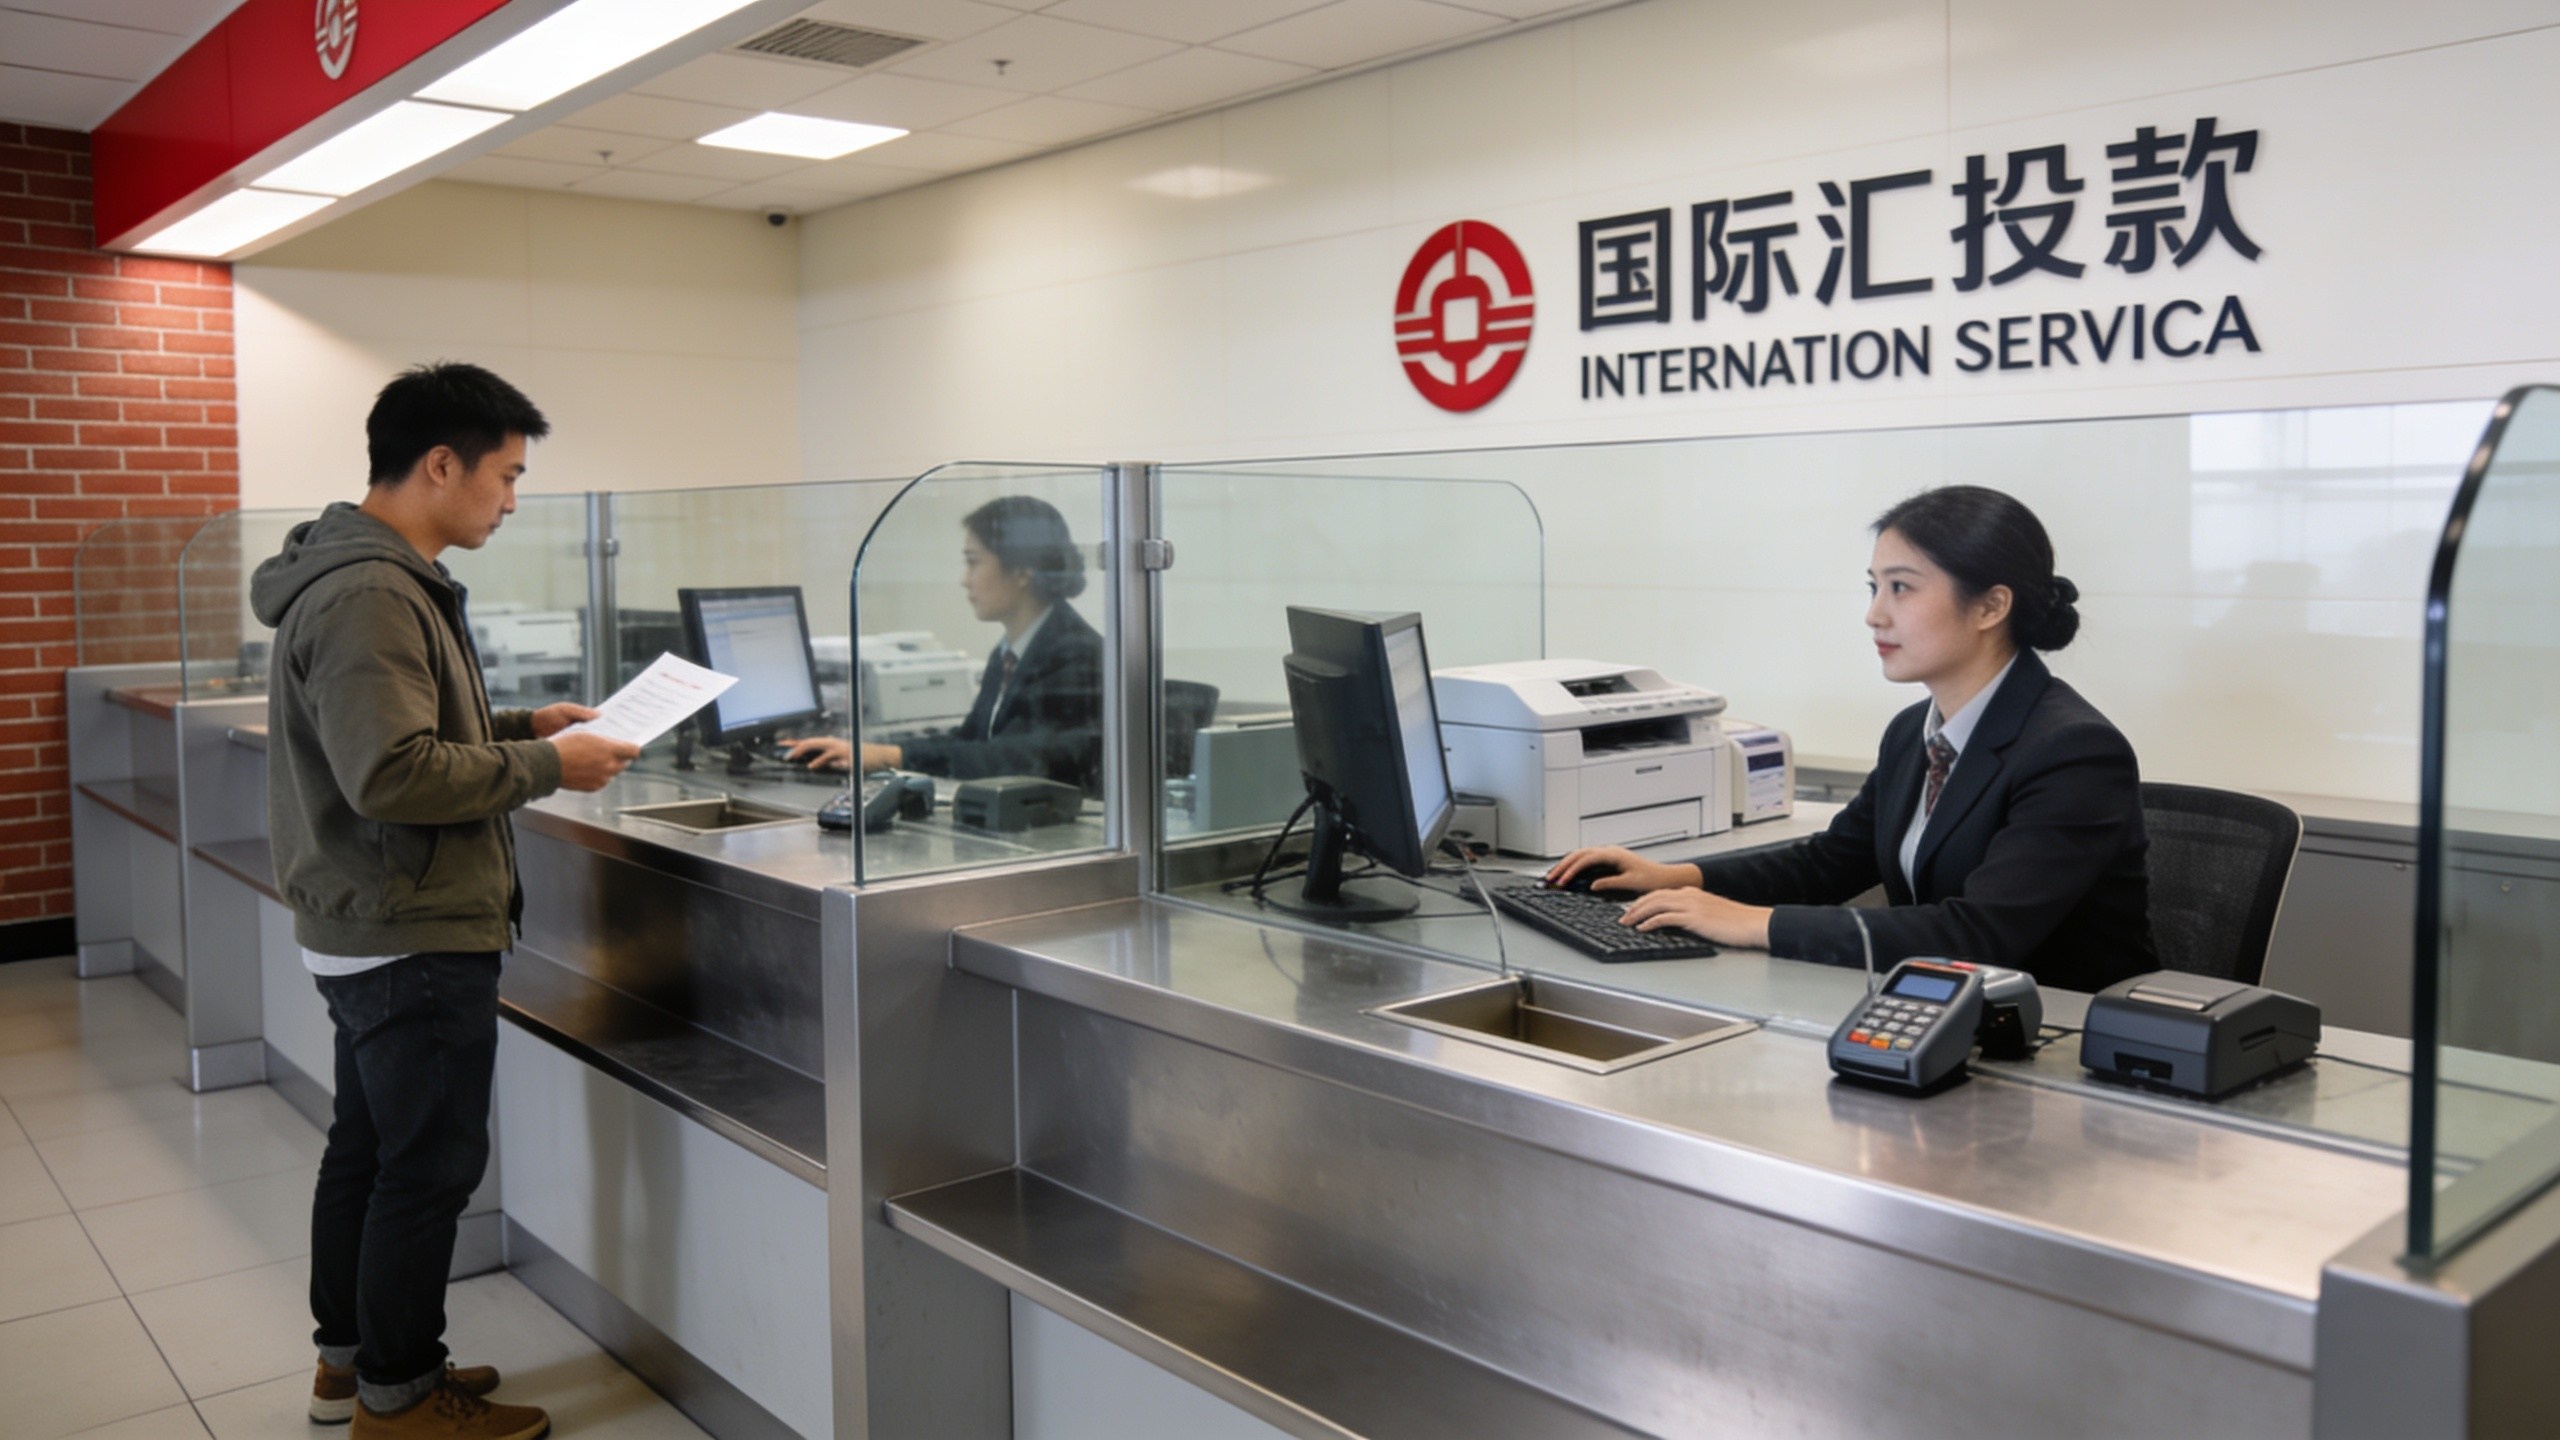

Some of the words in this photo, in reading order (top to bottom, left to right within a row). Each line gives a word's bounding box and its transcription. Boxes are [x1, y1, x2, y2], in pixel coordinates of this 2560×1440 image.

[1578, 116, 2263, 332] 国际汇投款
[1580, 325, 1931, 401] INTERNATION
[1955, 295, 2263, 374] SERVICA
